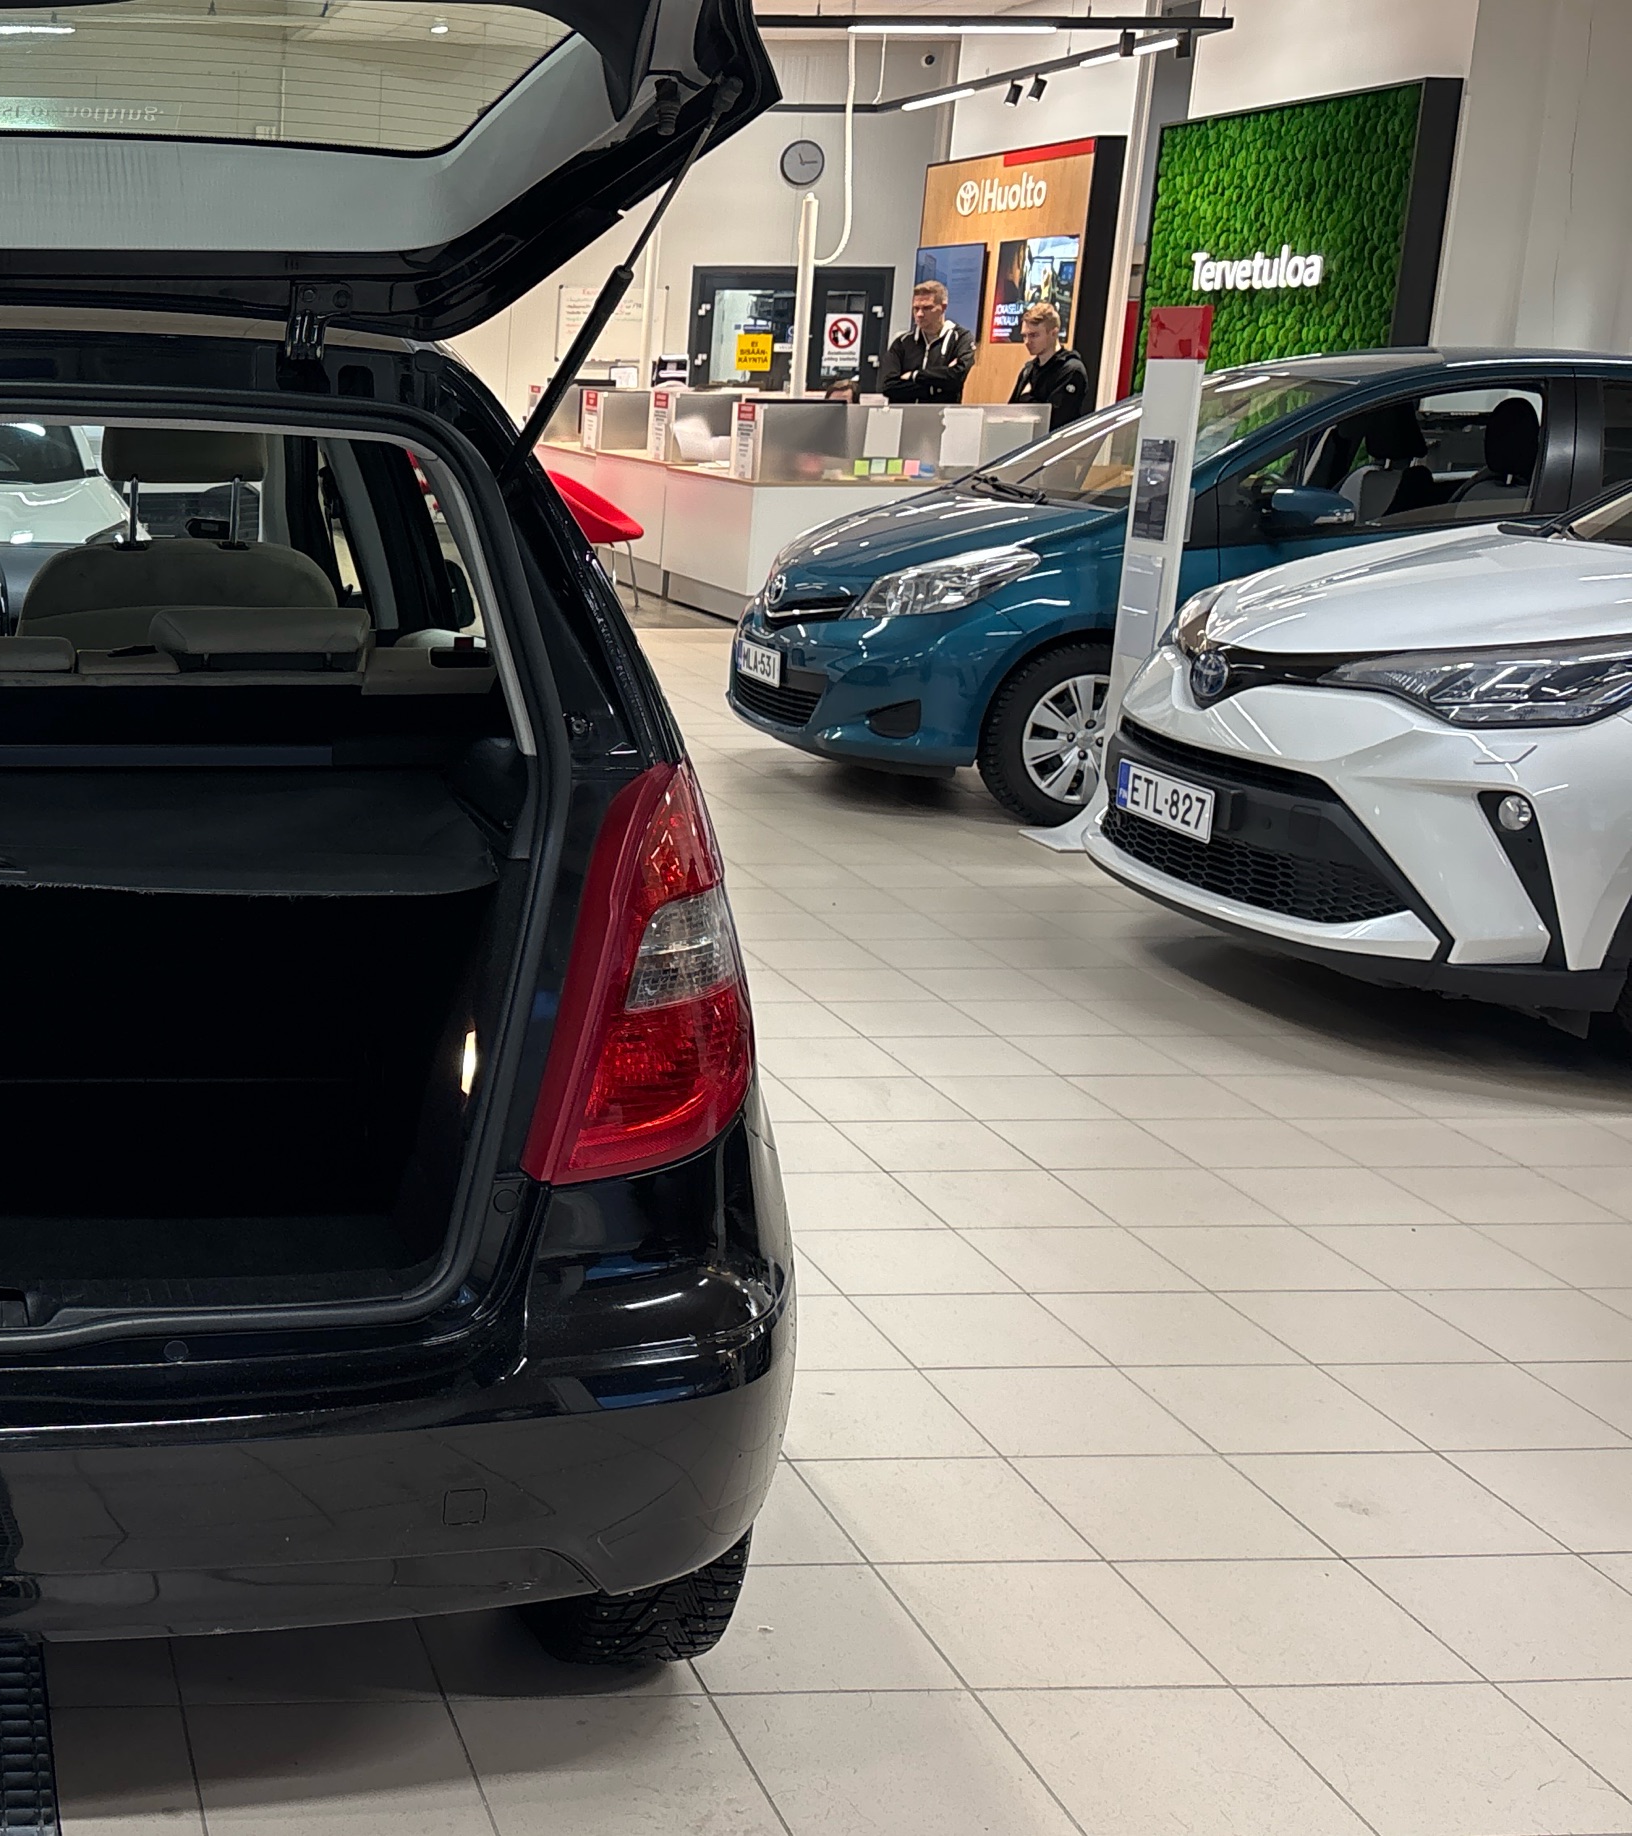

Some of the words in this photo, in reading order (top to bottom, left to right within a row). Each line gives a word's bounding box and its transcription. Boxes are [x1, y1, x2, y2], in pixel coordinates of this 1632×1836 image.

[982, 172, 1047, 213] Huolto
[1191, 244, 1323, 292] Tervetuloa
[1130, 773, 1207, 830] ETL-827
